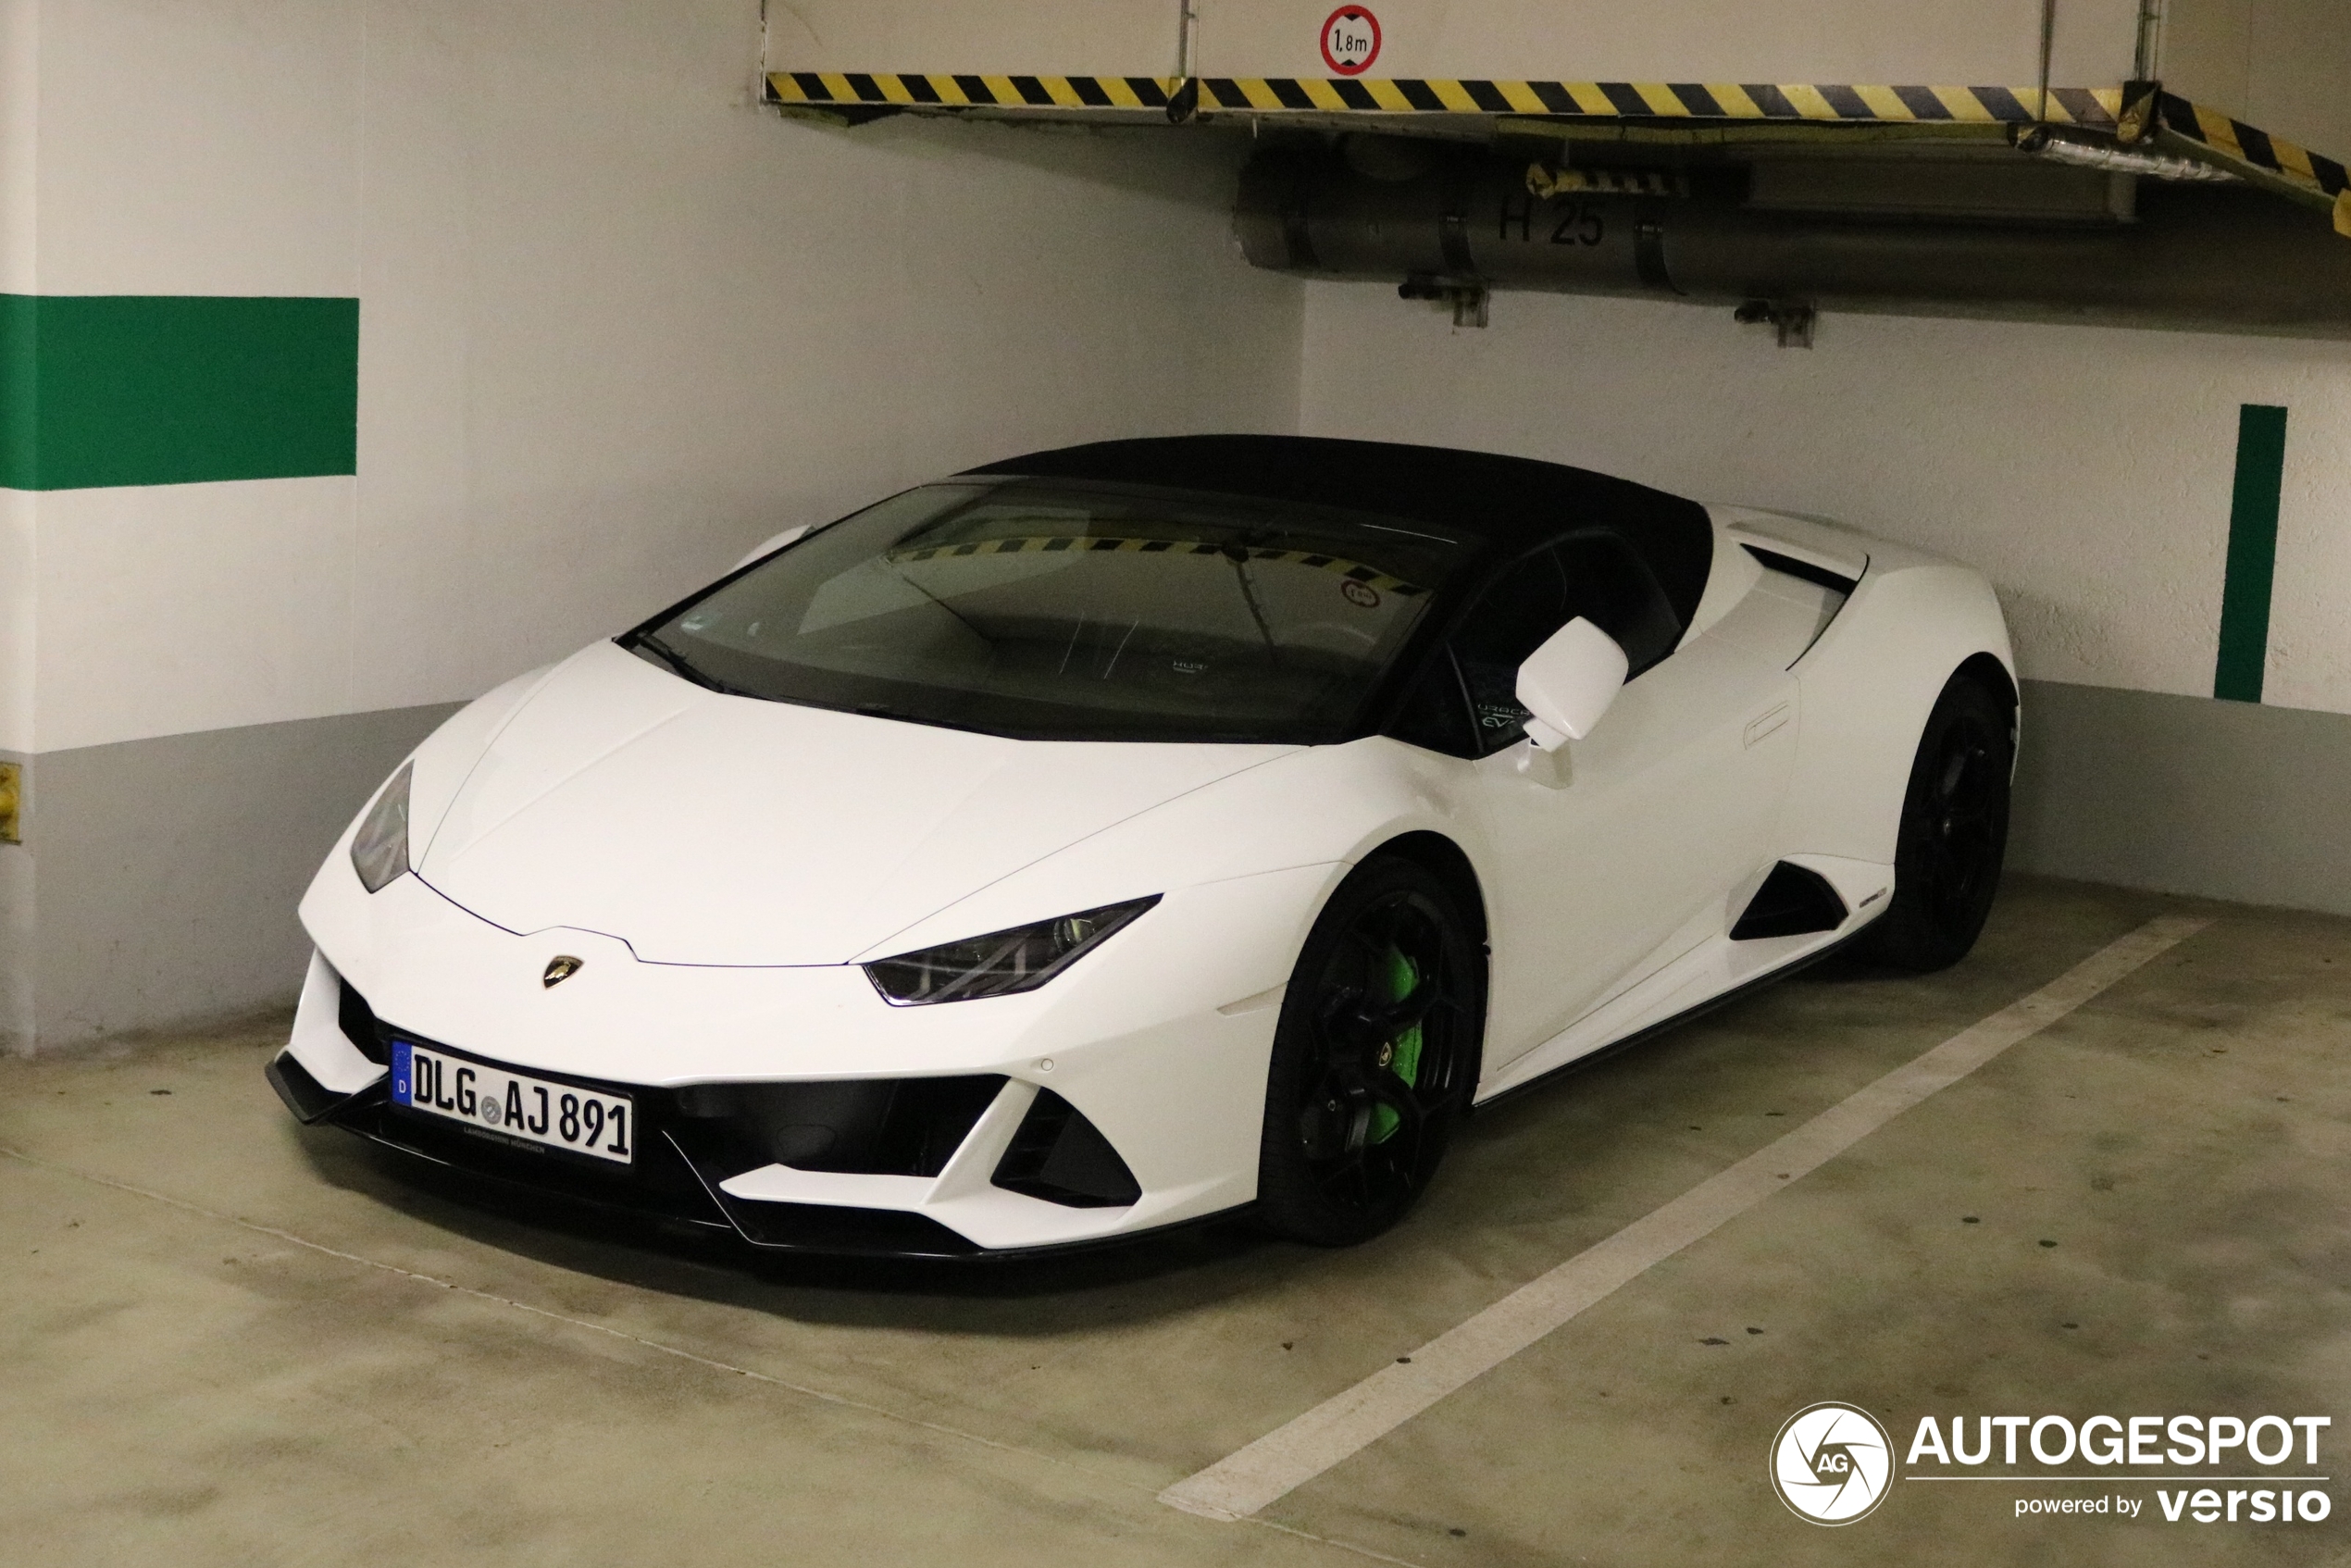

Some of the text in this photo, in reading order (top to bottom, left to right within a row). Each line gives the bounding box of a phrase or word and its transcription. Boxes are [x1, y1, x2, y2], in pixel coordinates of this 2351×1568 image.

[1499, 195, 1604, 246] H 25
[398, 1078, 406, 1093] D
[414, 1053, 629, 1155] DLG AJ 891
